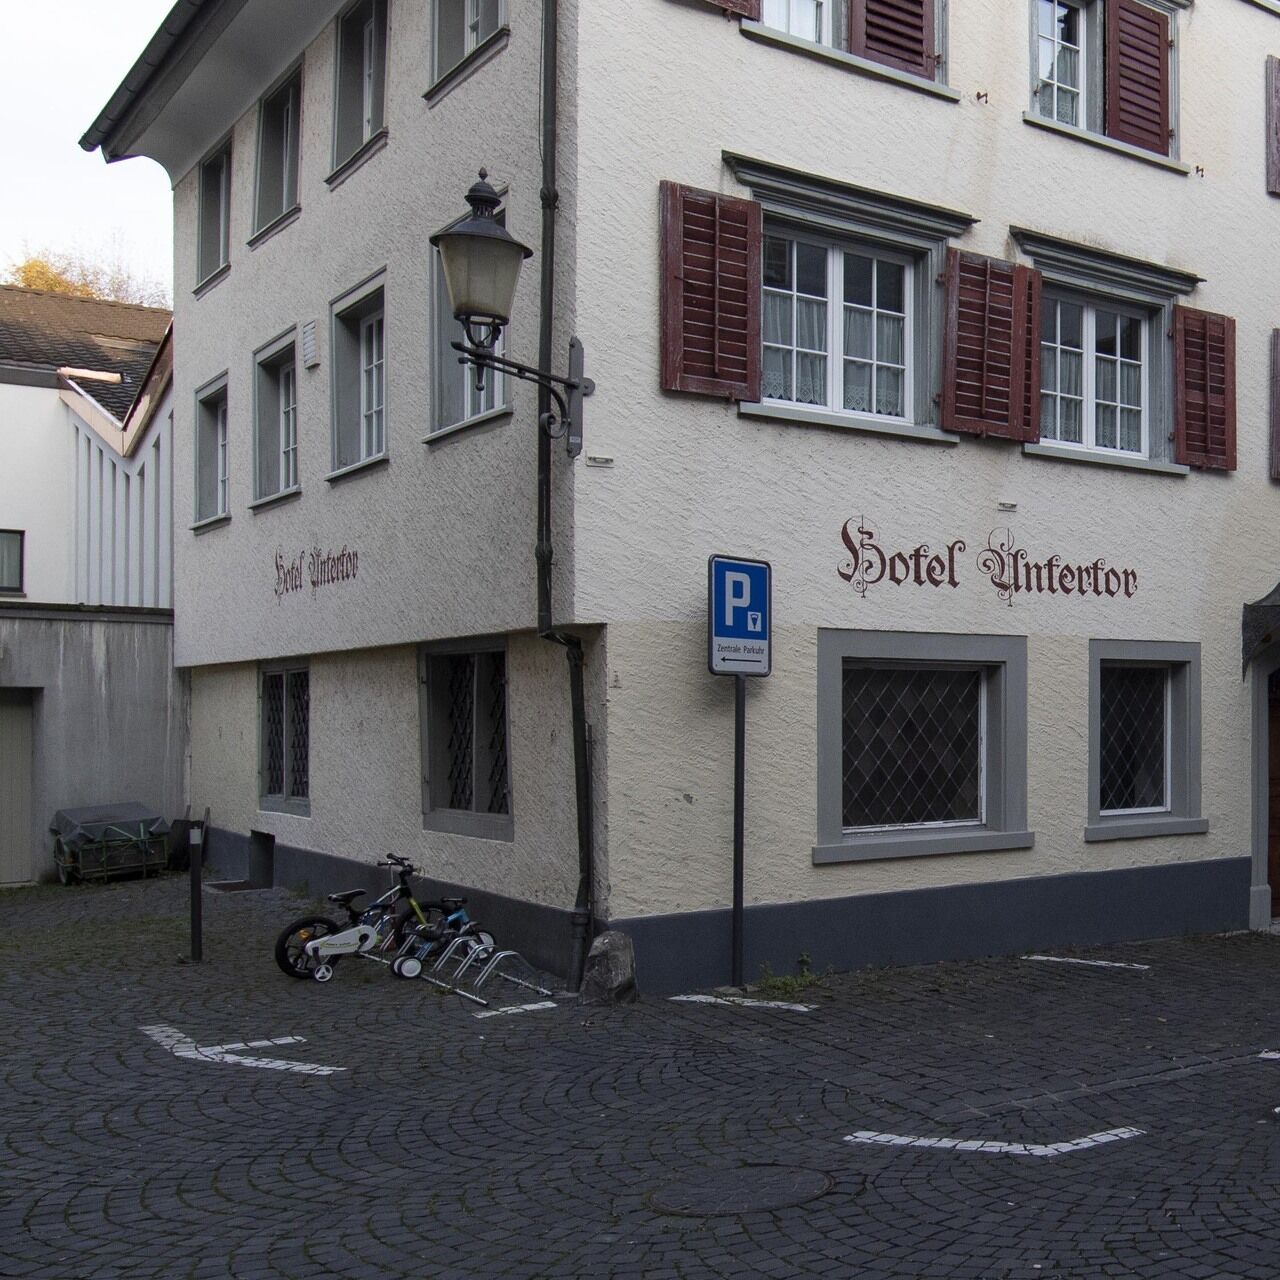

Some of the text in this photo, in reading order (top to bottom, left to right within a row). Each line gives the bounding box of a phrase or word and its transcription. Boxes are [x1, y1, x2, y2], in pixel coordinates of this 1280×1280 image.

[274, 544, 359, 605] Hotel Untertor
[836, 515, 1138, 608] Hotel Untertor
[725, 570, 751, 627] P
[717, 644, 765, 655] Zentrale Parkuhr
